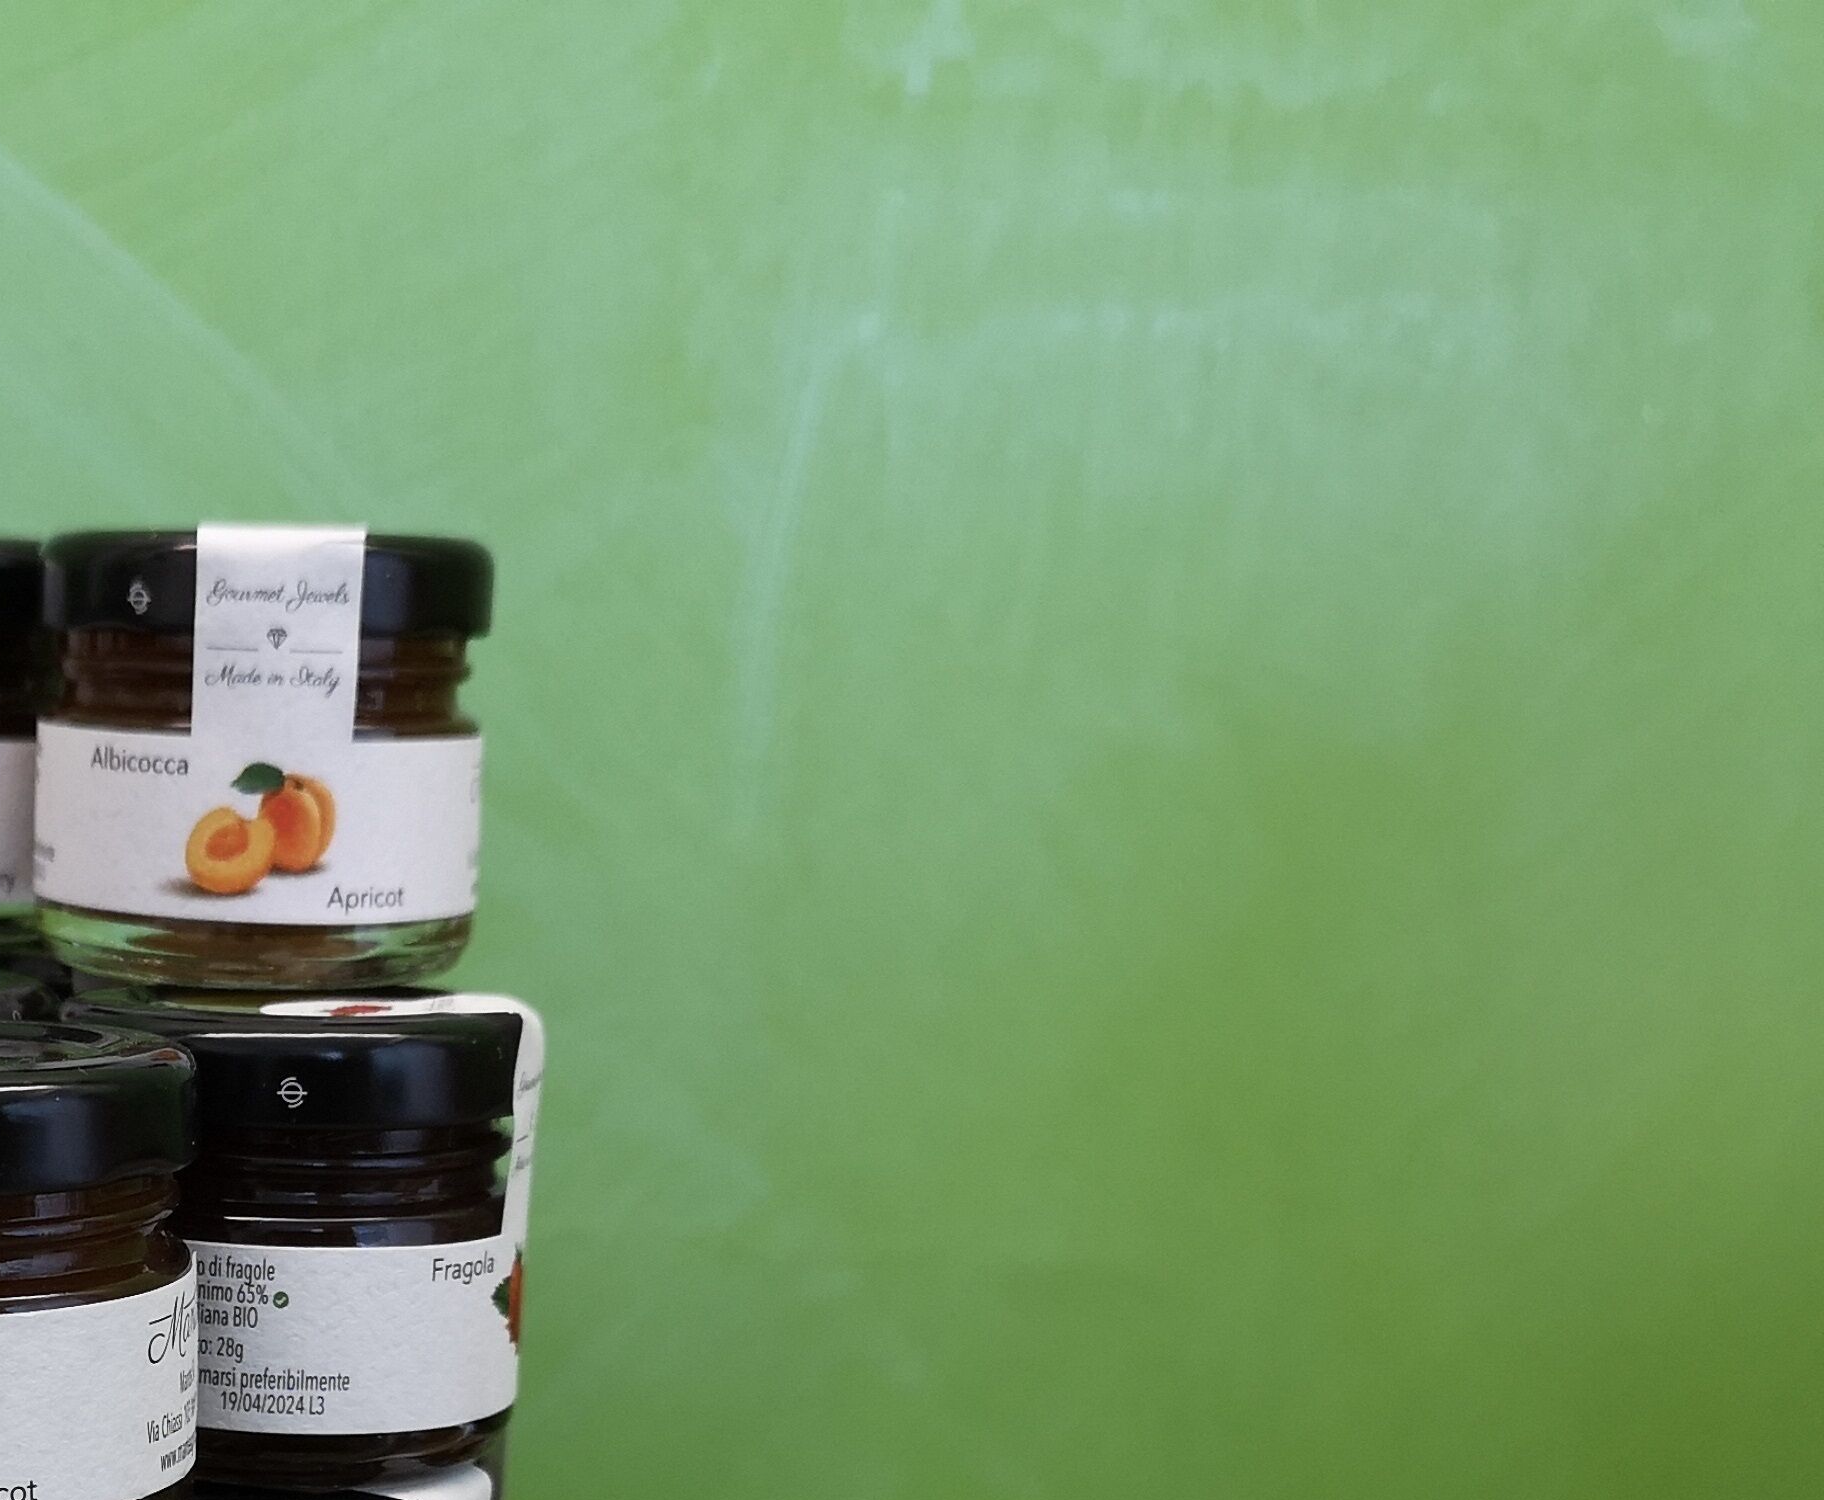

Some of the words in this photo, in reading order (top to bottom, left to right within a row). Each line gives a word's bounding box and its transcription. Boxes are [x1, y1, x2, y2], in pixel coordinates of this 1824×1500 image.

[206, 580, 283, 608] Gourmet
[286, 580, 350, 611] Jewels
[204, 665, 262, 689] Made
[267, 674, 284, 687] in
[290, 666, 341, 696] Italy
[91, 746, 190, 776] Albicocca
[327, 886, 405, 912] Apricot
[209, 1256, 222, 1277] di
[226, 1258, 275, 1285] fragole
[432, 1252, 495, 1285] Fragola
[198, 1282, 233, 1301] nimo
[236, 1284, 269, 1305] 65%
[233, 1306, 259, 1328] BIO
[217, 1337, 244, 1364] 28g
[198, 1367, 236, 1387] marsi
[240, 1367, 350, 1394] preferibilmente
[220, 1391, 305, 1415] 19/04/2024
[309, 1396, 325, 1416] L3
